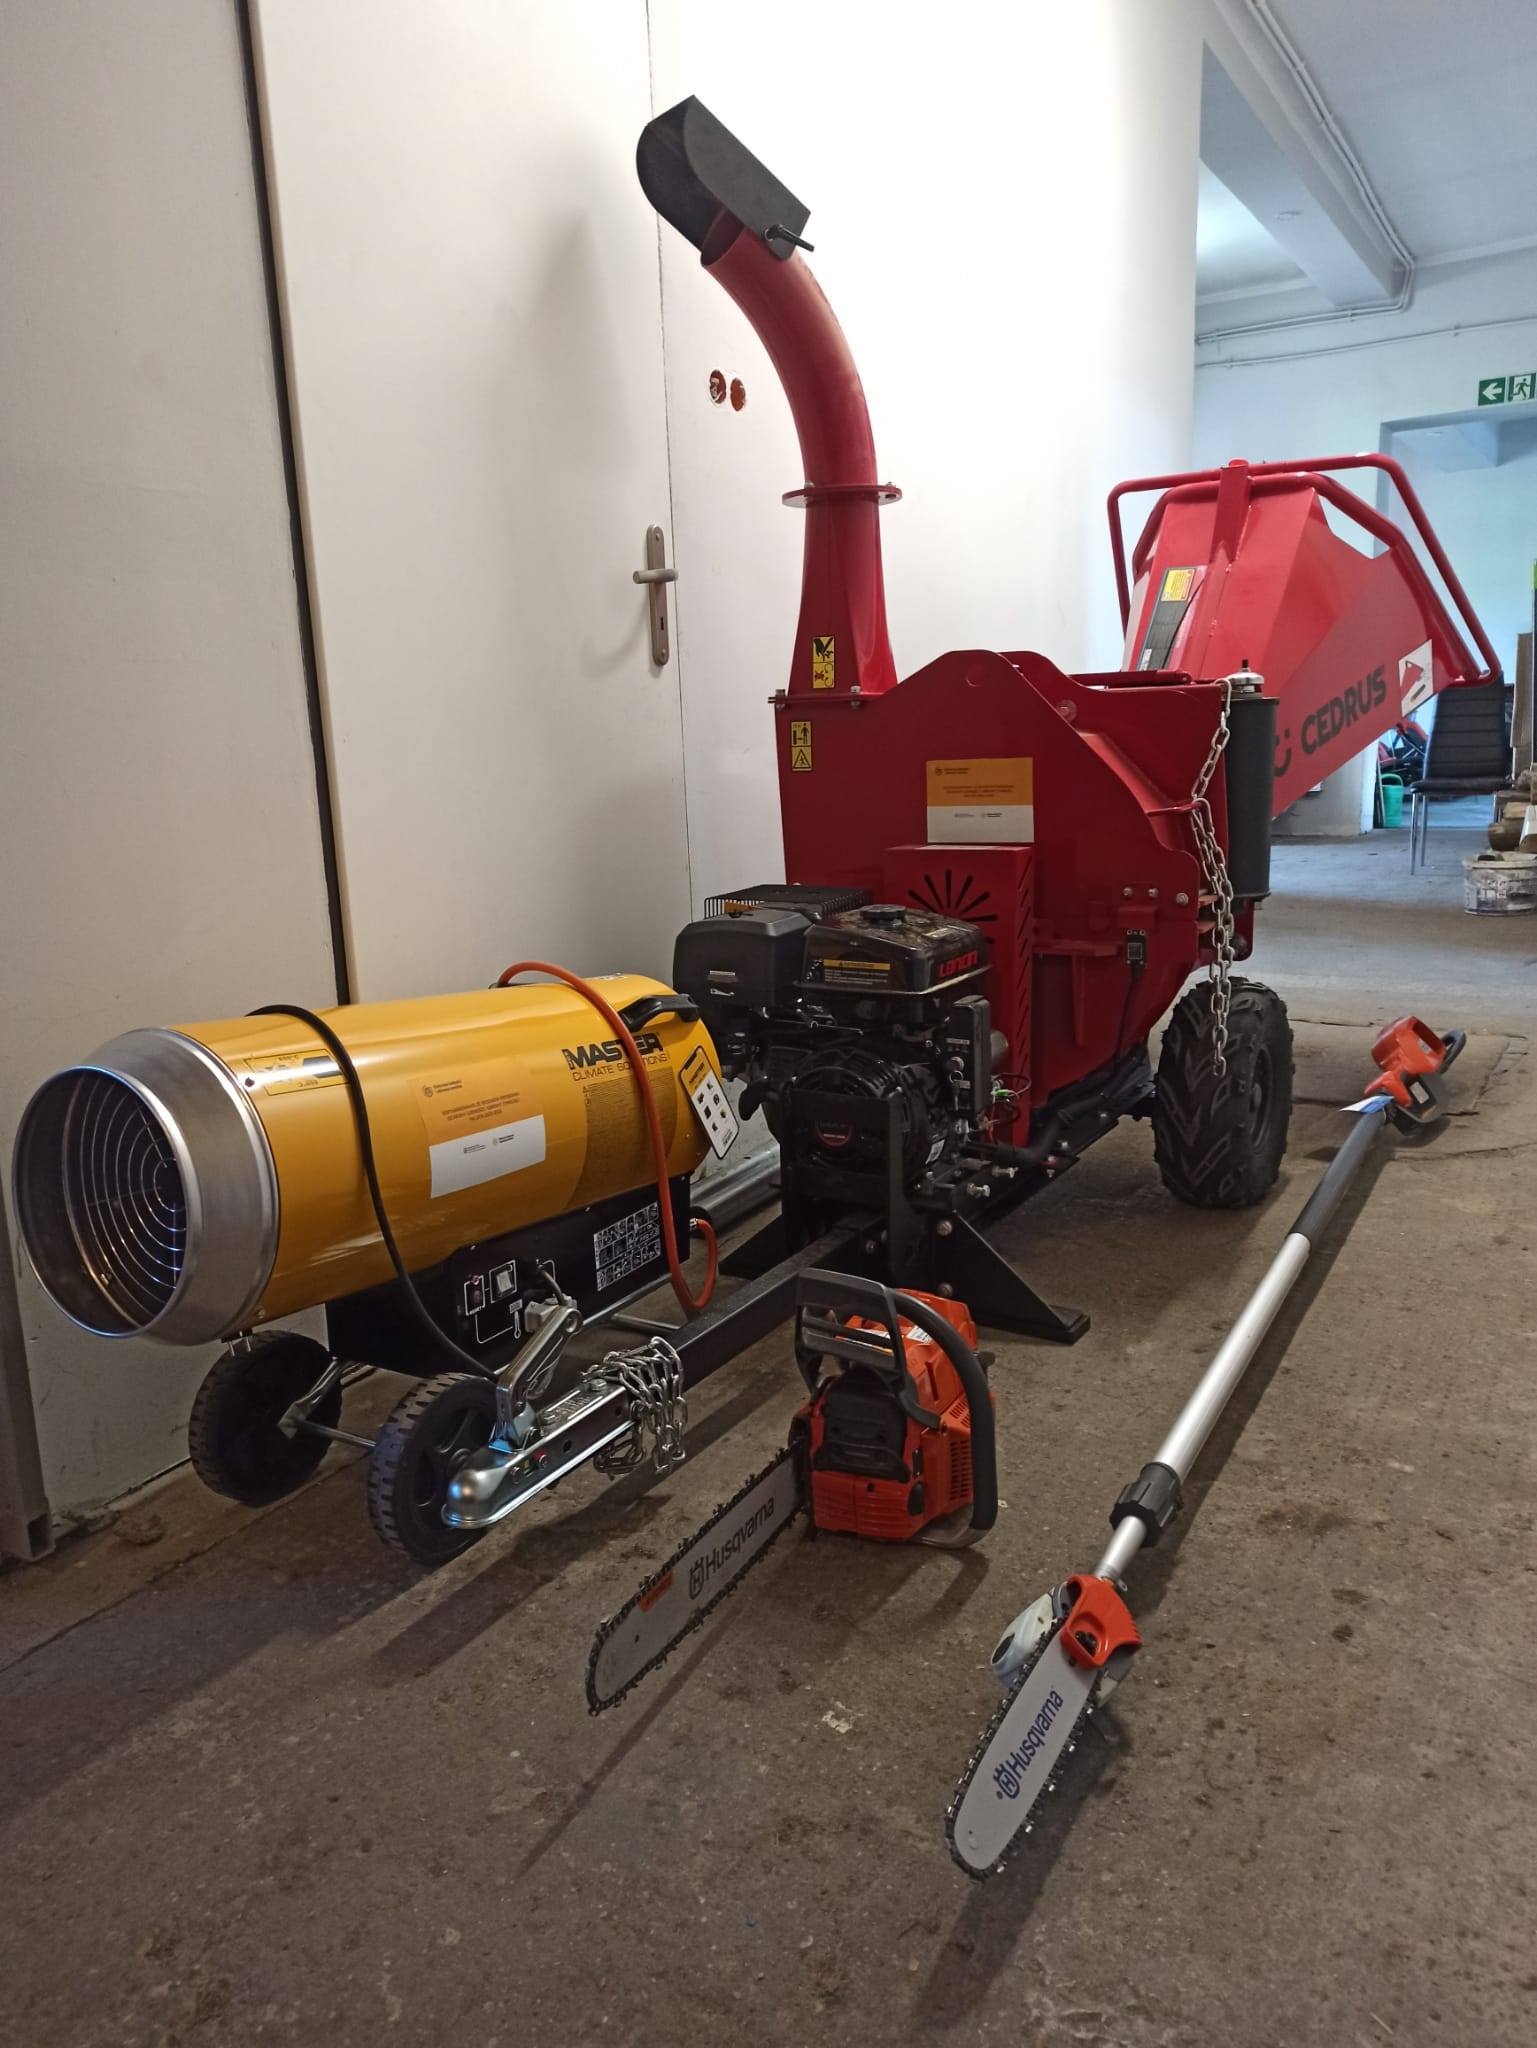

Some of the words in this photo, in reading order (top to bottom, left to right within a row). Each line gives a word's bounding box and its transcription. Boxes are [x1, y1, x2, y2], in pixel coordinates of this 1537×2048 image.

[1301, 664, 1387, 755] CEDRUS
[564, 1032, 663, 1069] MASER
[572, 1064, 615, 1081] CLIMATE
[705, 1496, 775, 1581] Husqvarna
[1006, 1690, 1064, 1780] Husqvarna
